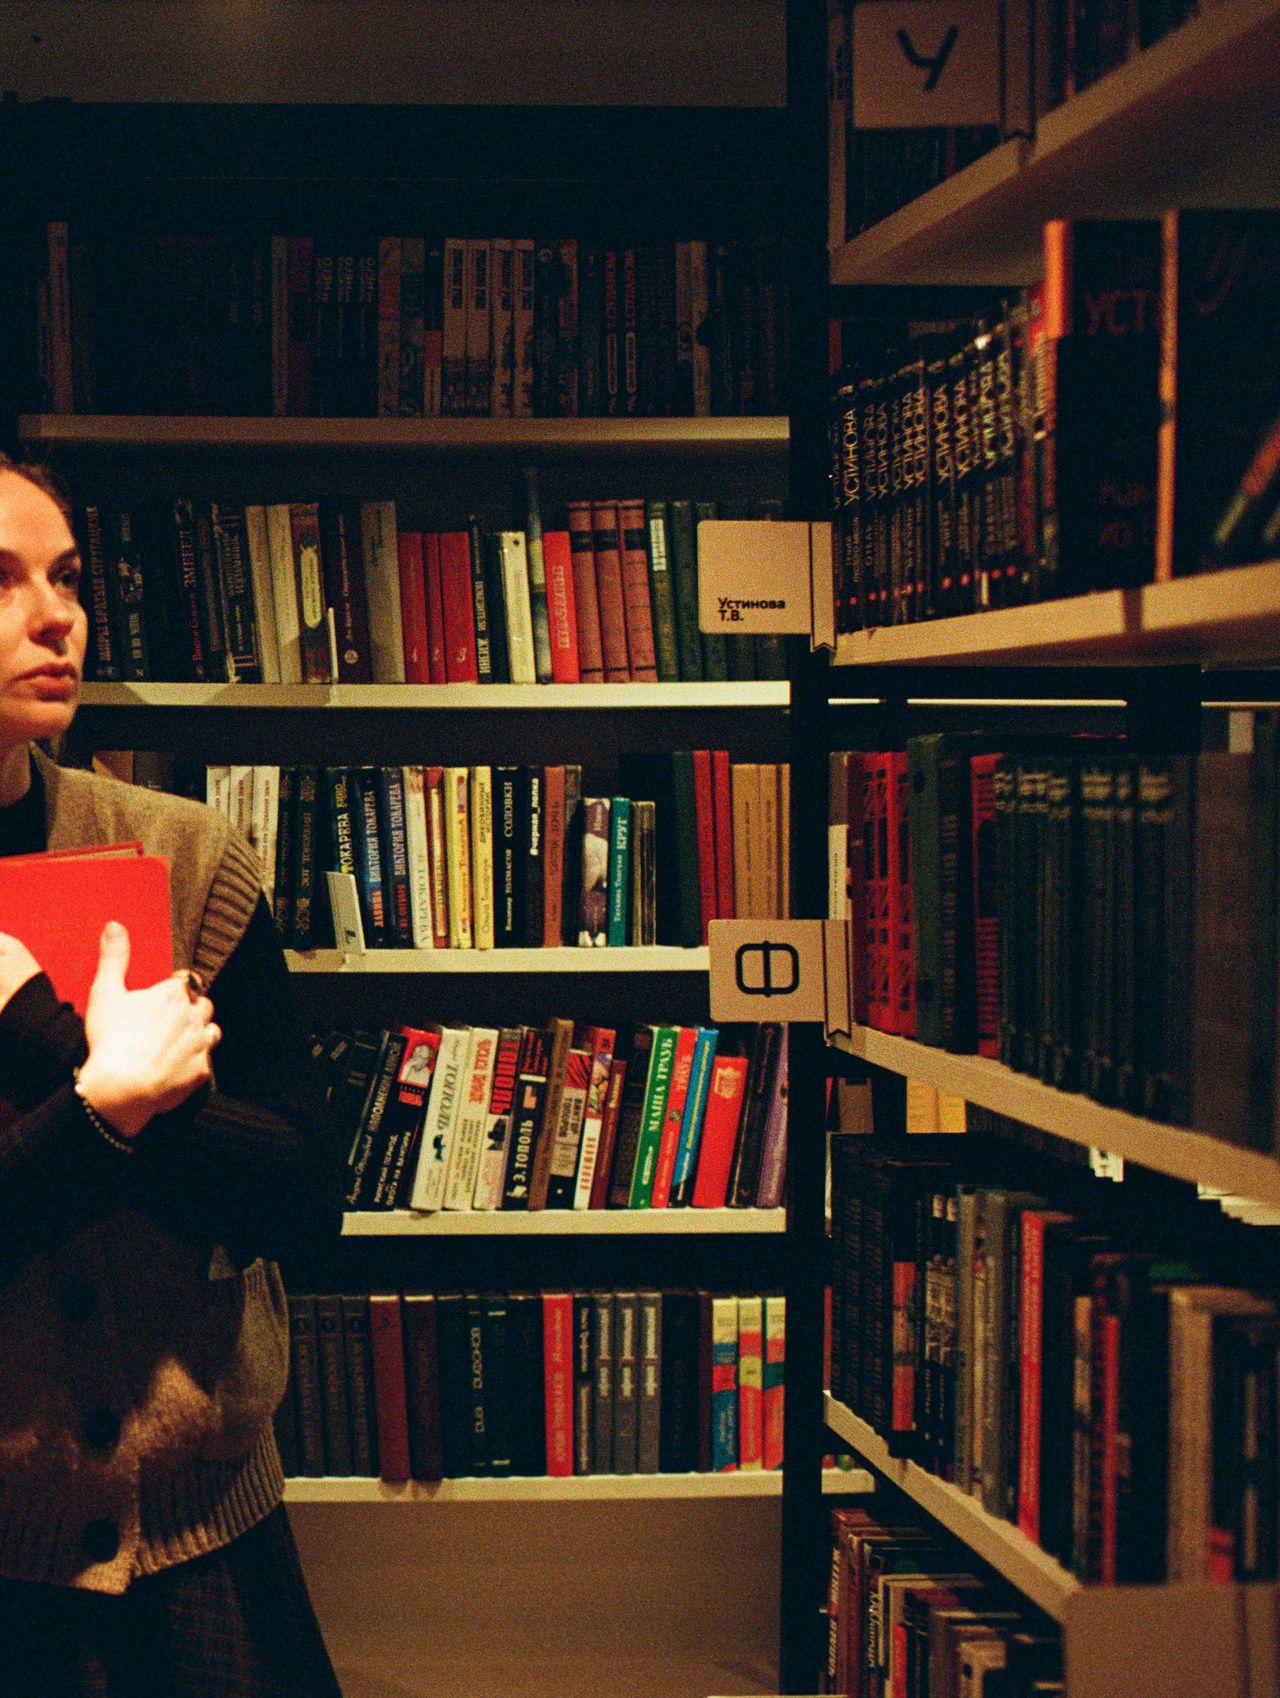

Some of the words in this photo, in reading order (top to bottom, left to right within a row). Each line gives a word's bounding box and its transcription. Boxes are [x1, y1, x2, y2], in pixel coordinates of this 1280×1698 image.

[897, 25, 961, 92] У
[901, 391, 914, 490] УСТИНОВА
[933, 383, 950, 485] УСТИНОВА
[952, 377, 970, 480] УСТИНОВА
[842, 408, 860, 506] УСТИНОВА
[86, 506, 104, 575] СТРУГАЦКИХ
[92, 577, 107, 624] БРАТЬЕВ
[717, 597, 786, 610] Устинова
[718, 609, 744, 622] Т.В.
[97, 626, 111, 662] МИРЫ
[363, 790, 378, 835] ТОКАРЕВА
[388, 783, 403, 828] ТОКАРЕВА
[503, 781, 515, 838] СОЛОВКИ
[337, 812, 355, 874] ТОКАРЕВА
[391, 830, 406, 877] ВИКТОРИЯ
[616, 816, 628, 850] КРУГ
[366, 837, 382, 883] ВИКТОРИЯ
[504, 849, 513, 894] ТОЛМАСОВ
[372, 889, 384, 928] ЛАВИНА
[735, 940, 800, 998] Ф
[489, 1040, 521, 1114] ТОПОЛЬ
[655, 1038, 674, 1083] ТРАУБ
[437, 1064, 458, 1131] ТОПОЛЬ
[558, 1097, 572, 1138] ТОПОРОВ
[569, 1098, 582, 1135] ВИКТОР
[647, 1085, 665, 1132] МАША
[514, 1119, 534, 1169] ТОПОЛЬ
